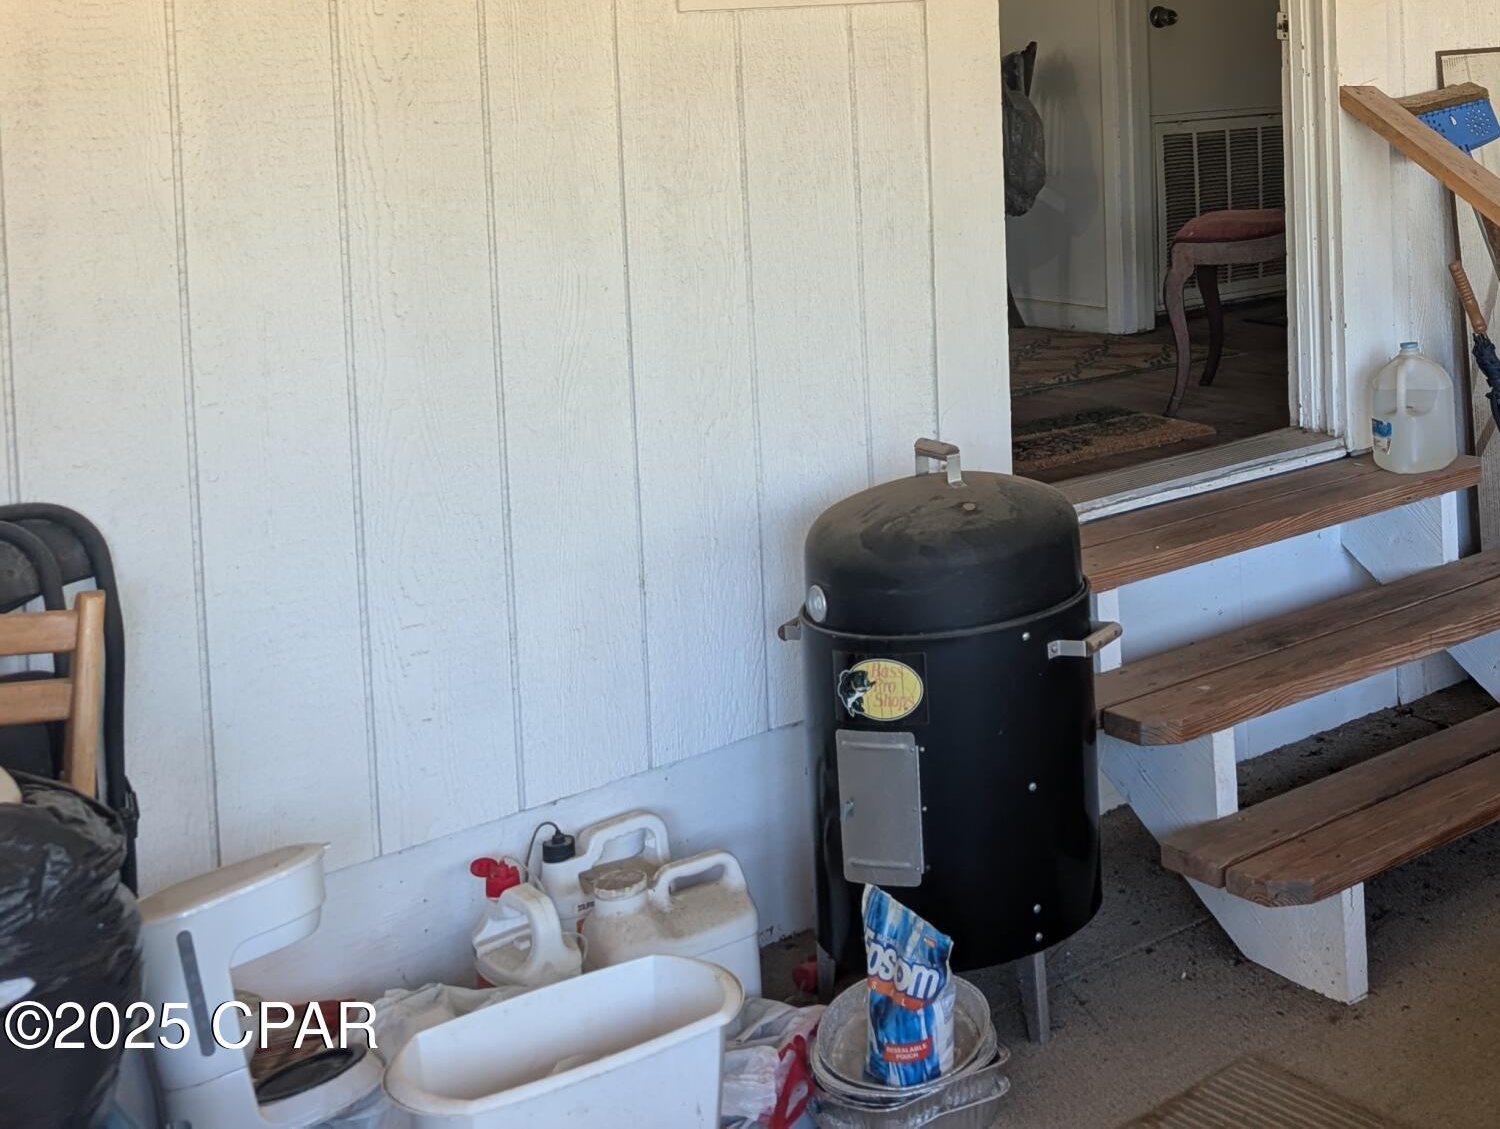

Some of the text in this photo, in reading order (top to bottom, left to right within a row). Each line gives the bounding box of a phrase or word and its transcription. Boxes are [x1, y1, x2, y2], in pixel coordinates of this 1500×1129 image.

[872, 662, 904, 679] Bass
[874, 679, 897, 693] Pro
[874, 692, 915, 712] Shops
[895, 1052, 919, 1061] POUCH
